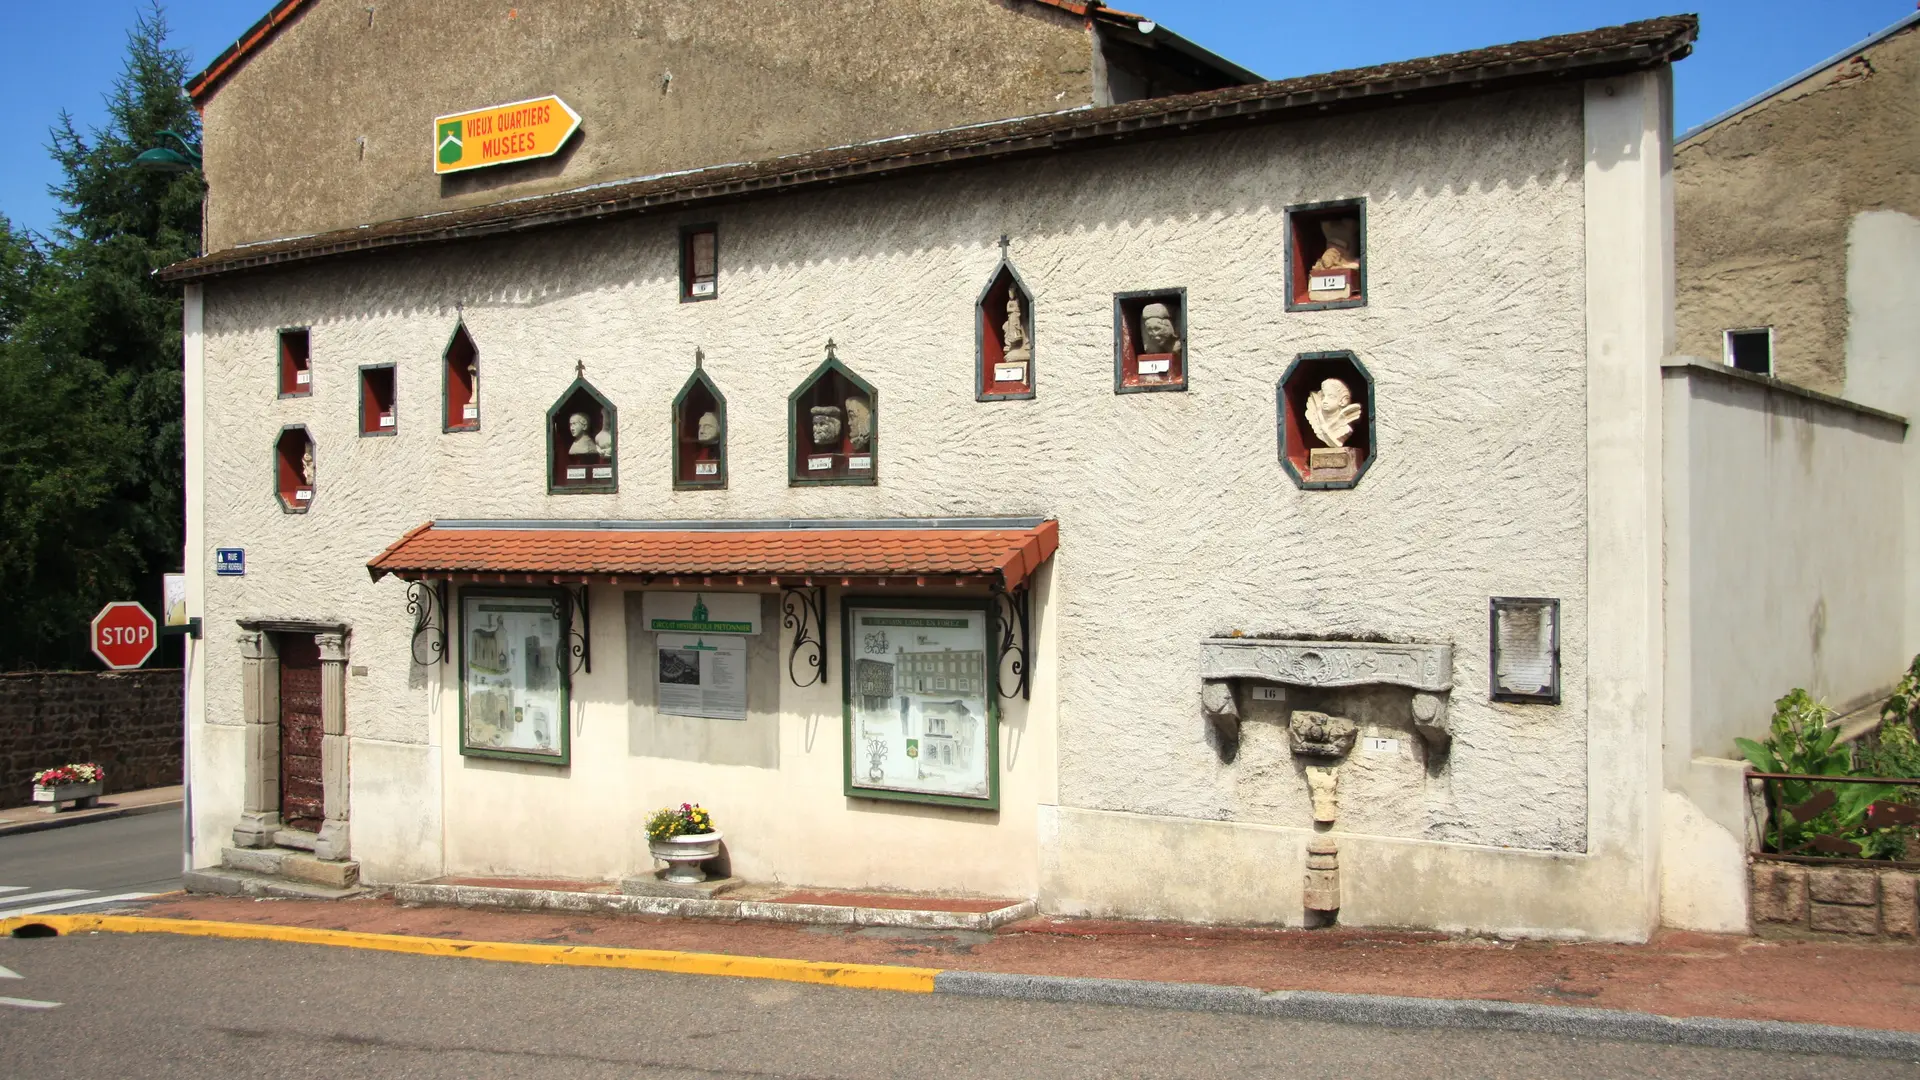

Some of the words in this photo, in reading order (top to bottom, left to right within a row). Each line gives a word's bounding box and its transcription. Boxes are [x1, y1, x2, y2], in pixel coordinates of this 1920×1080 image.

[467, 116, 493, 138] VIEUX
[498, 105, 550, 132] QUARTIERS
[482, 132, 535, 158] MUSÉES
[1323, 278, 1335, 288] 12
[102, 626, 150, 646] STOP
[1264, 689, 1276, 699] 16
[1376, 740, 1387, 750] 17
